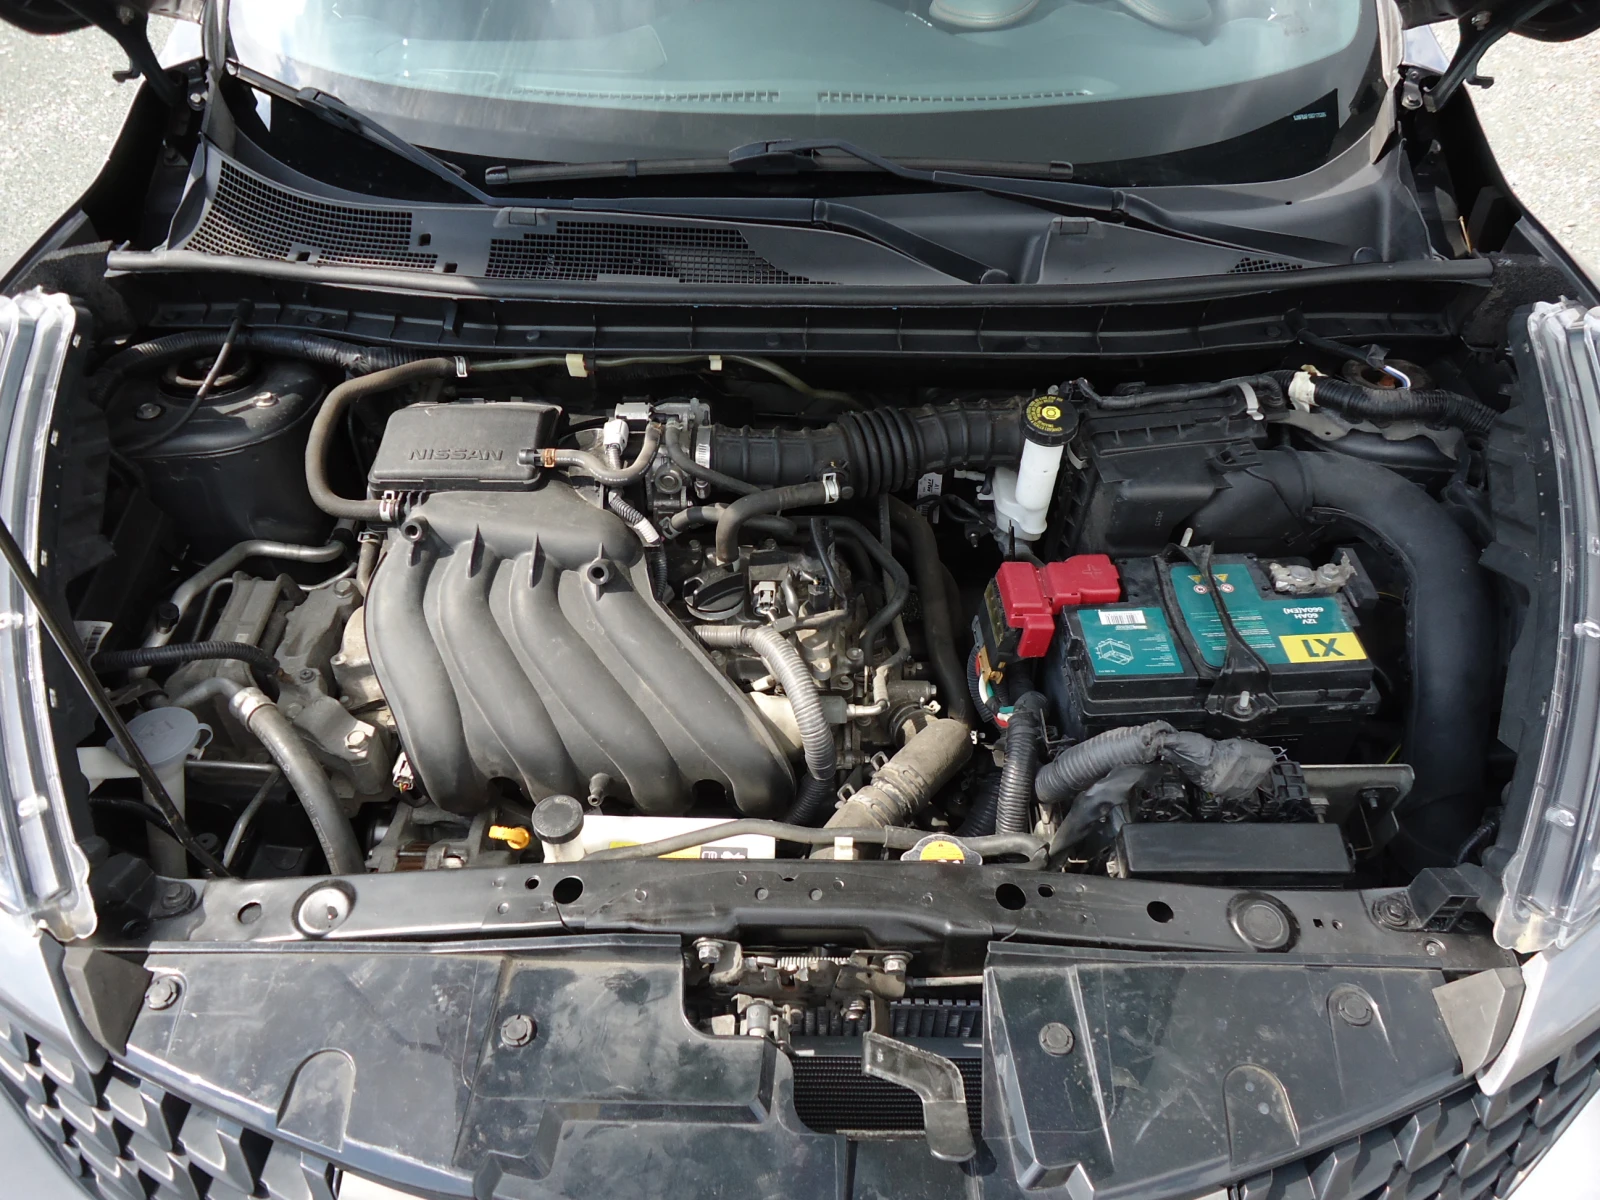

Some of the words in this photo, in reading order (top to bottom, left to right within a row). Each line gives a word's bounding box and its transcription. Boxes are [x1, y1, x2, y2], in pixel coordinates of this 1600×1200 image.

[408, 449, 503, 461] NISSAN
[1283, 606, 1324, 615] 660A(EN)
[1301, 638, 1346, 658] X1
